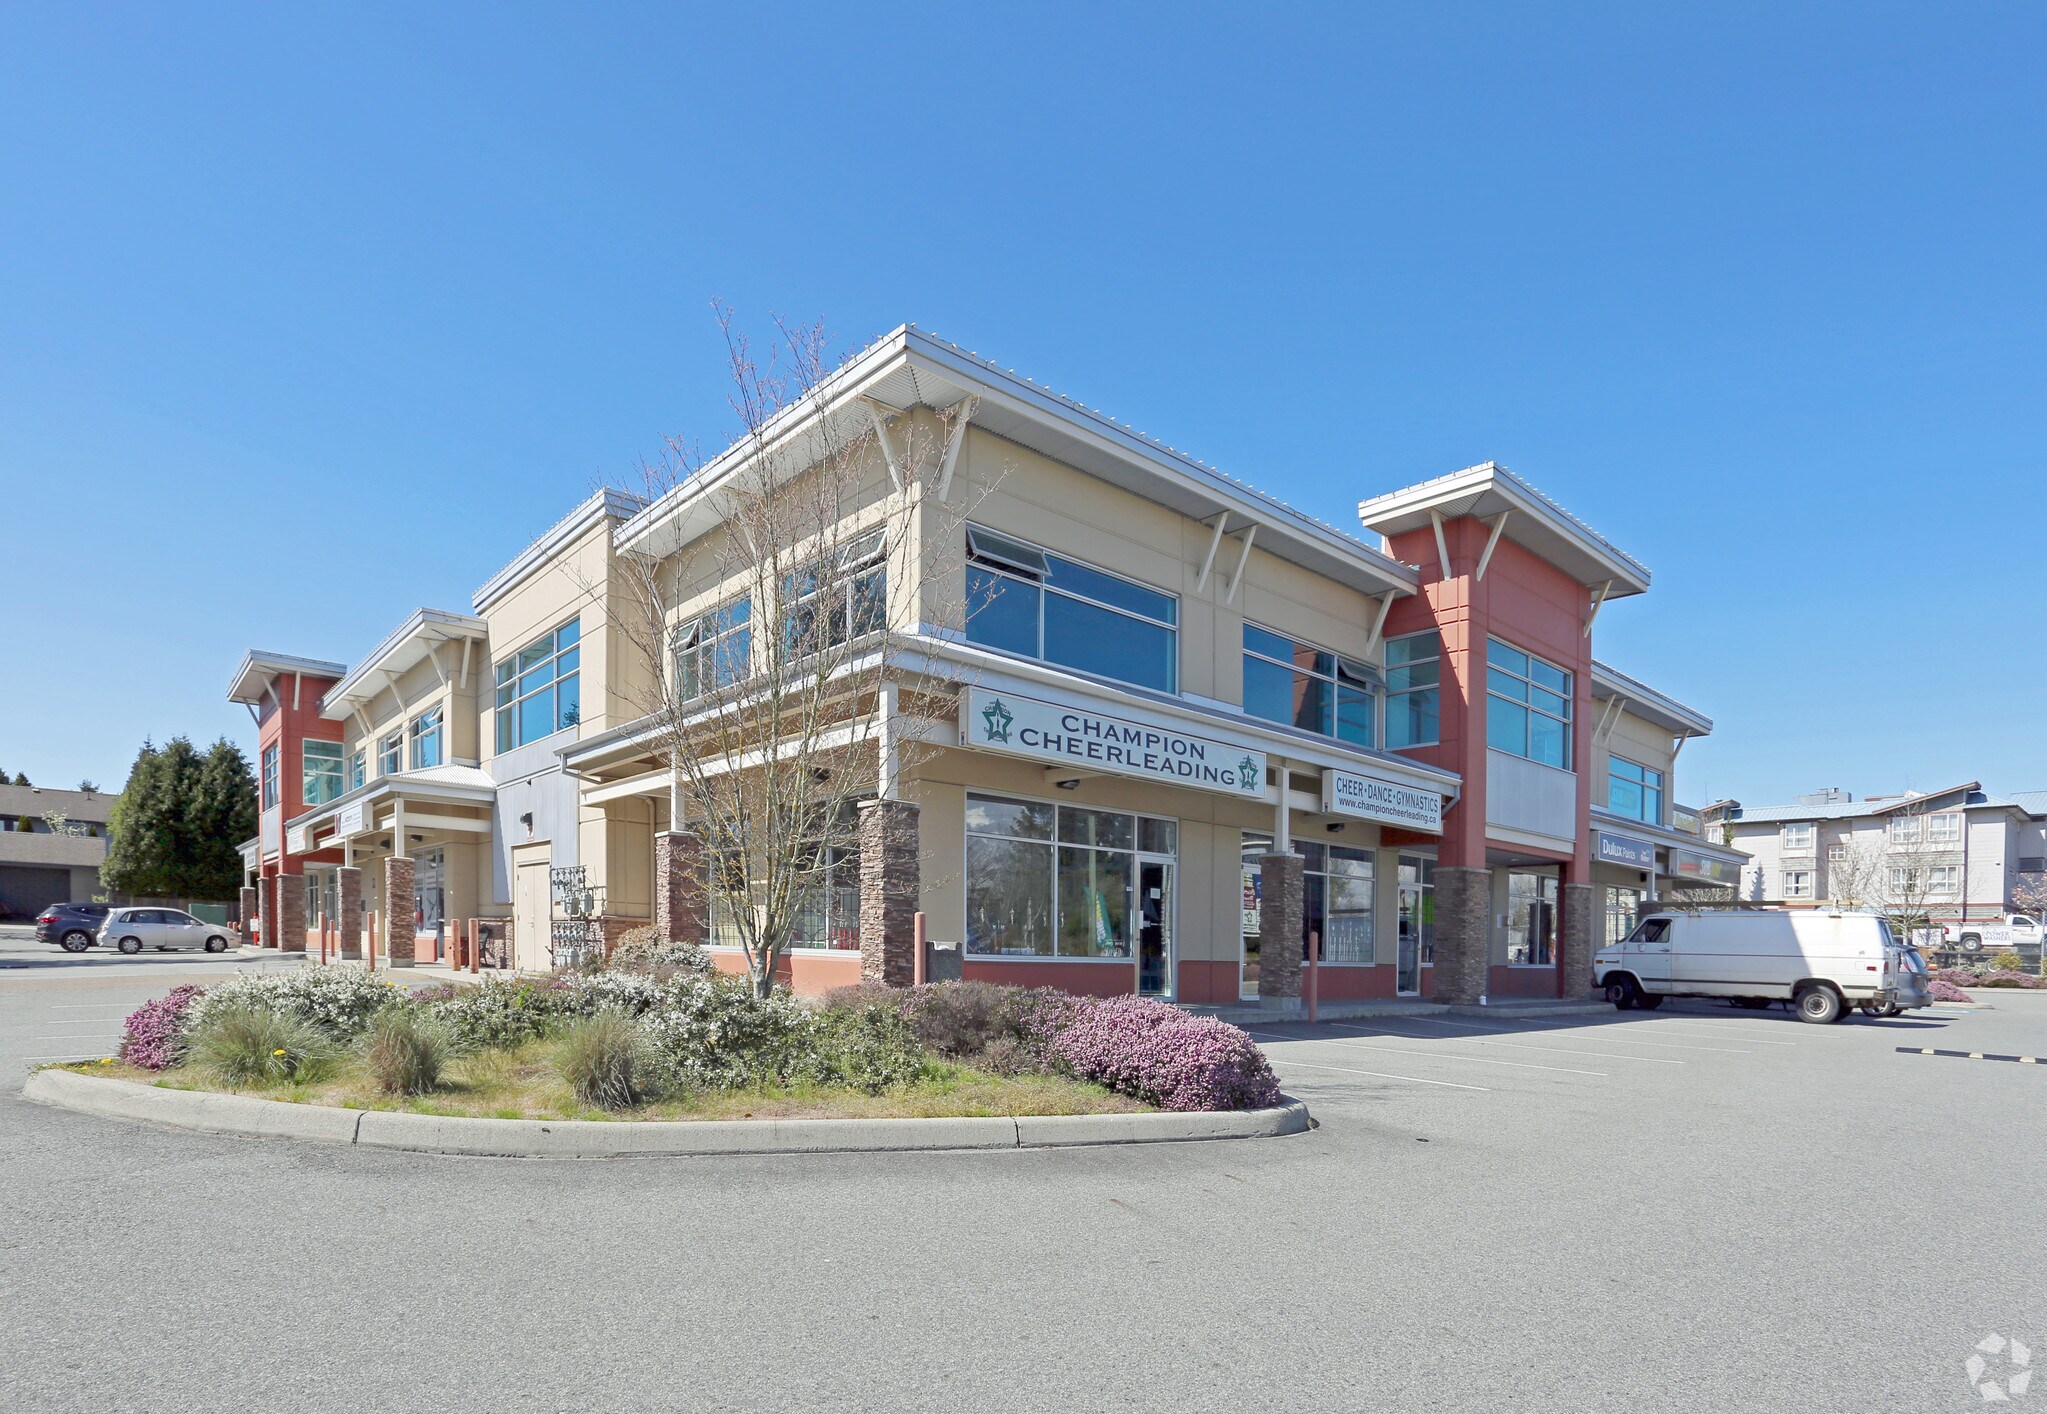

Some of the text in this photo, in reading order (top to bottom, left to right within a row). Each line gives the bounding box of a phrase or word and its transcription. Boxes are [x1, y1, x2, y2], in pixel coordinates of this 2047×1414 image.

[1061, 714, 1205, 760] CHAMPION
[1019, 728, 1235, 786] CHEERLEADING
[1336, 777, 1438, 813] CHEER DANCE GYMNASTICS
[1338, 796, 1437, 824] www.championcheerleading.ca
[1602, 839, 1622, 857] Dulux
[1622, 847, 1636, 860] Paints
